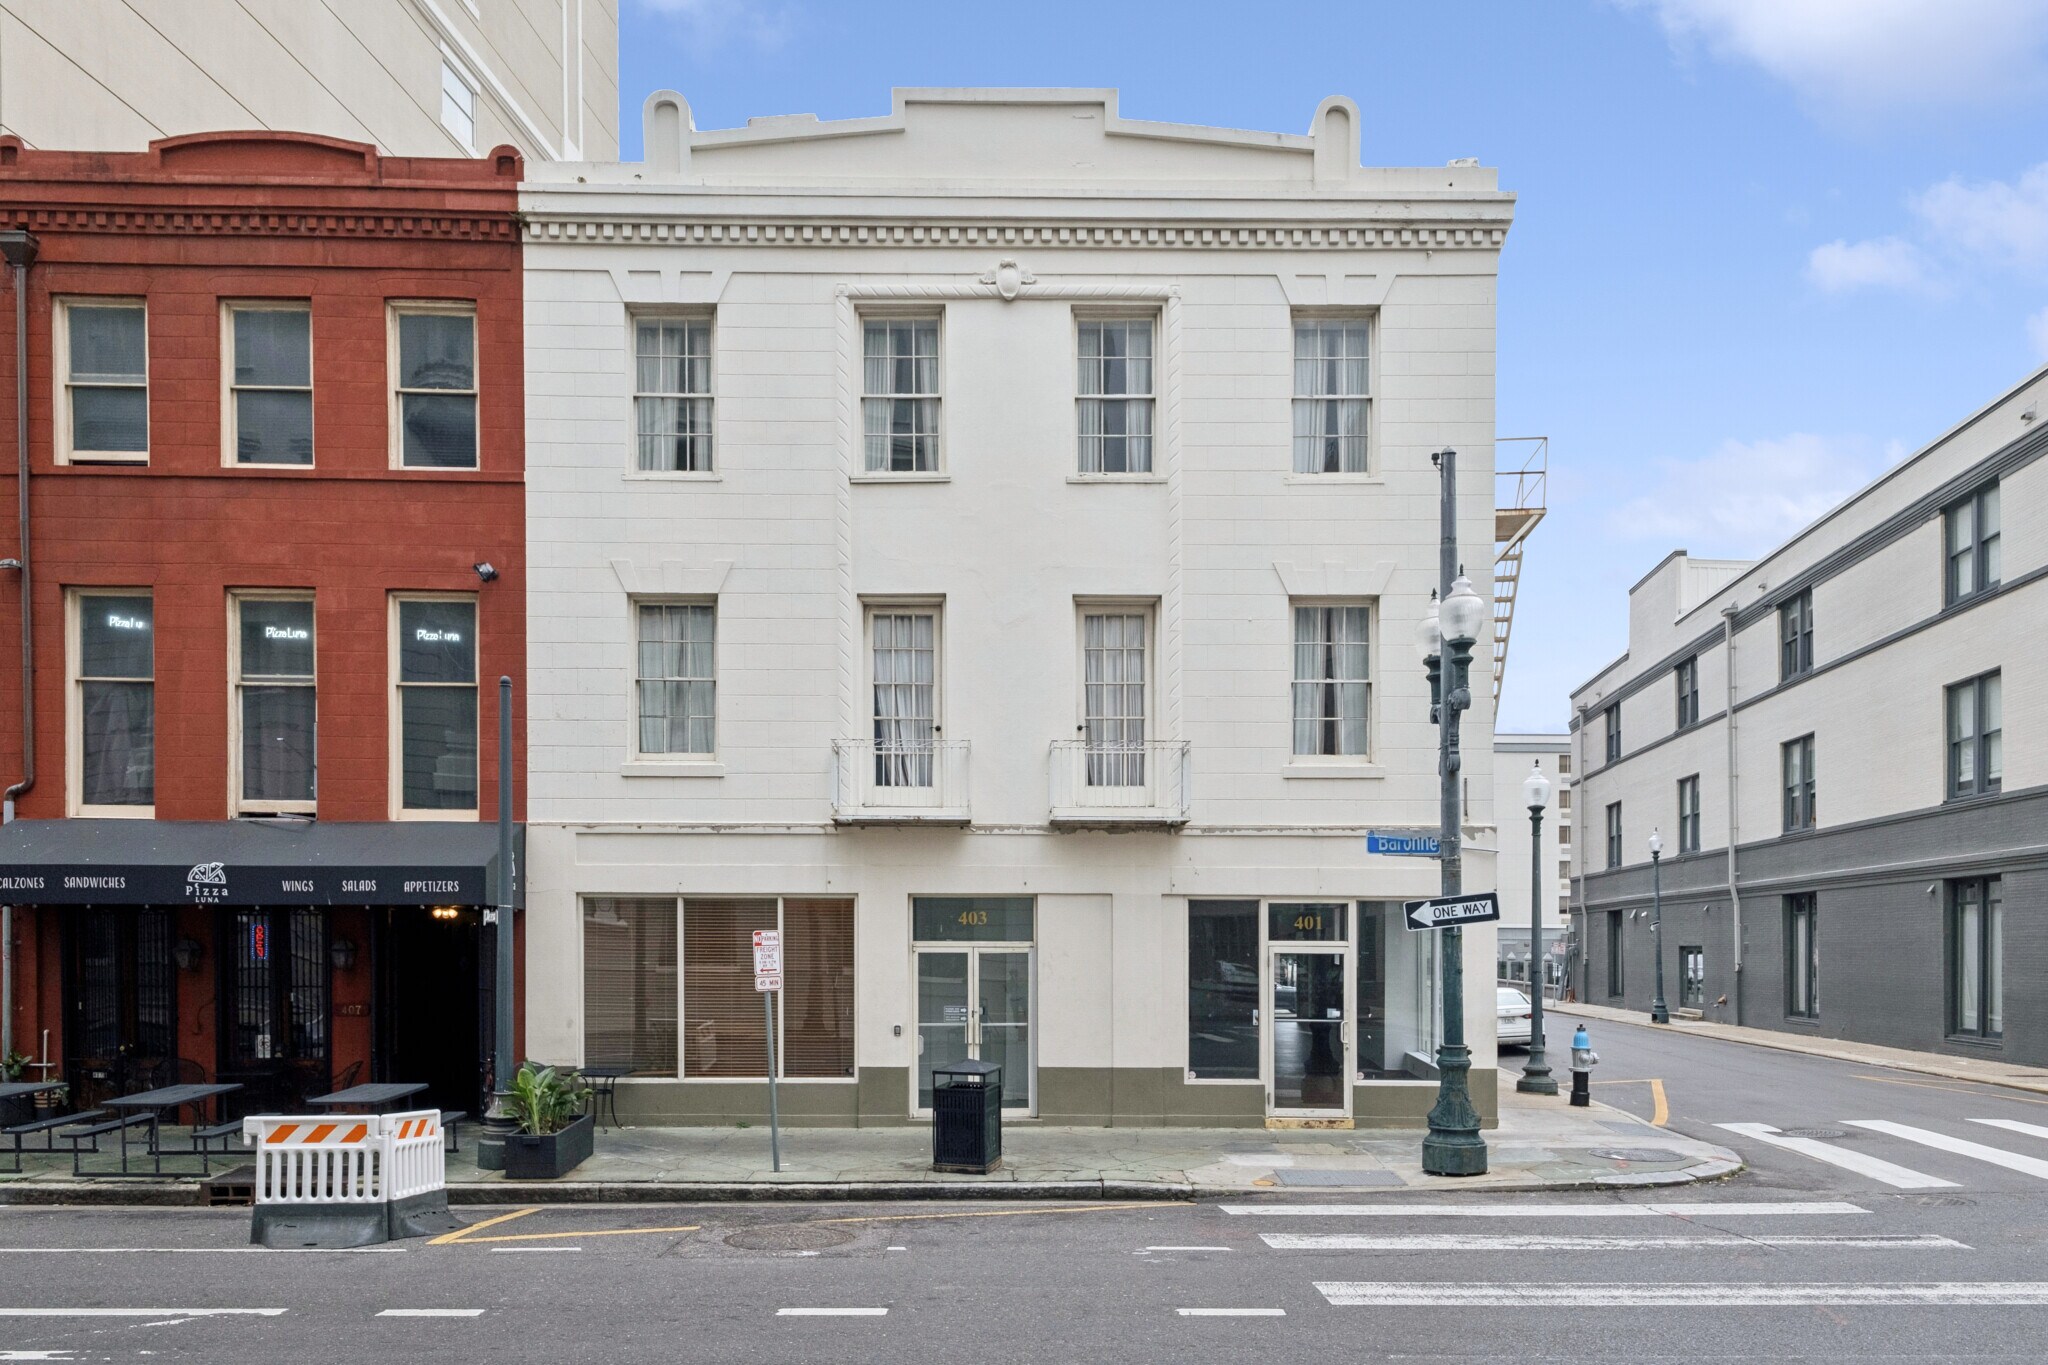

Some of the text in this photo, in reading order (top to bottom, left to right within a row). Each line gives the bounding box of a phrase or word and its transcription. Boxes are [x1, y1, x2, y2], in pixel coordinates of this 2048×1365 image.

[109, 615, 130, 628] Pizza
[265, 626, 308, 638] Pizza Luna
[417, 629, 438, 641] Pizza
[64, 876, 126, 889] SANDWICHES
[185, 882, 229, 896] Pizza
[282, 880, 314, 892] WINGS
[342, 880, 377, 892] SALADS
[404, 880, 460, 893] APPETIZERS
[1433, 901, 1489, 919] ONE WAY
[958, 911, 987, 925] 403
[1294, 915, 1322, 930] 401
[342, 1005, 361, 1015] 407
